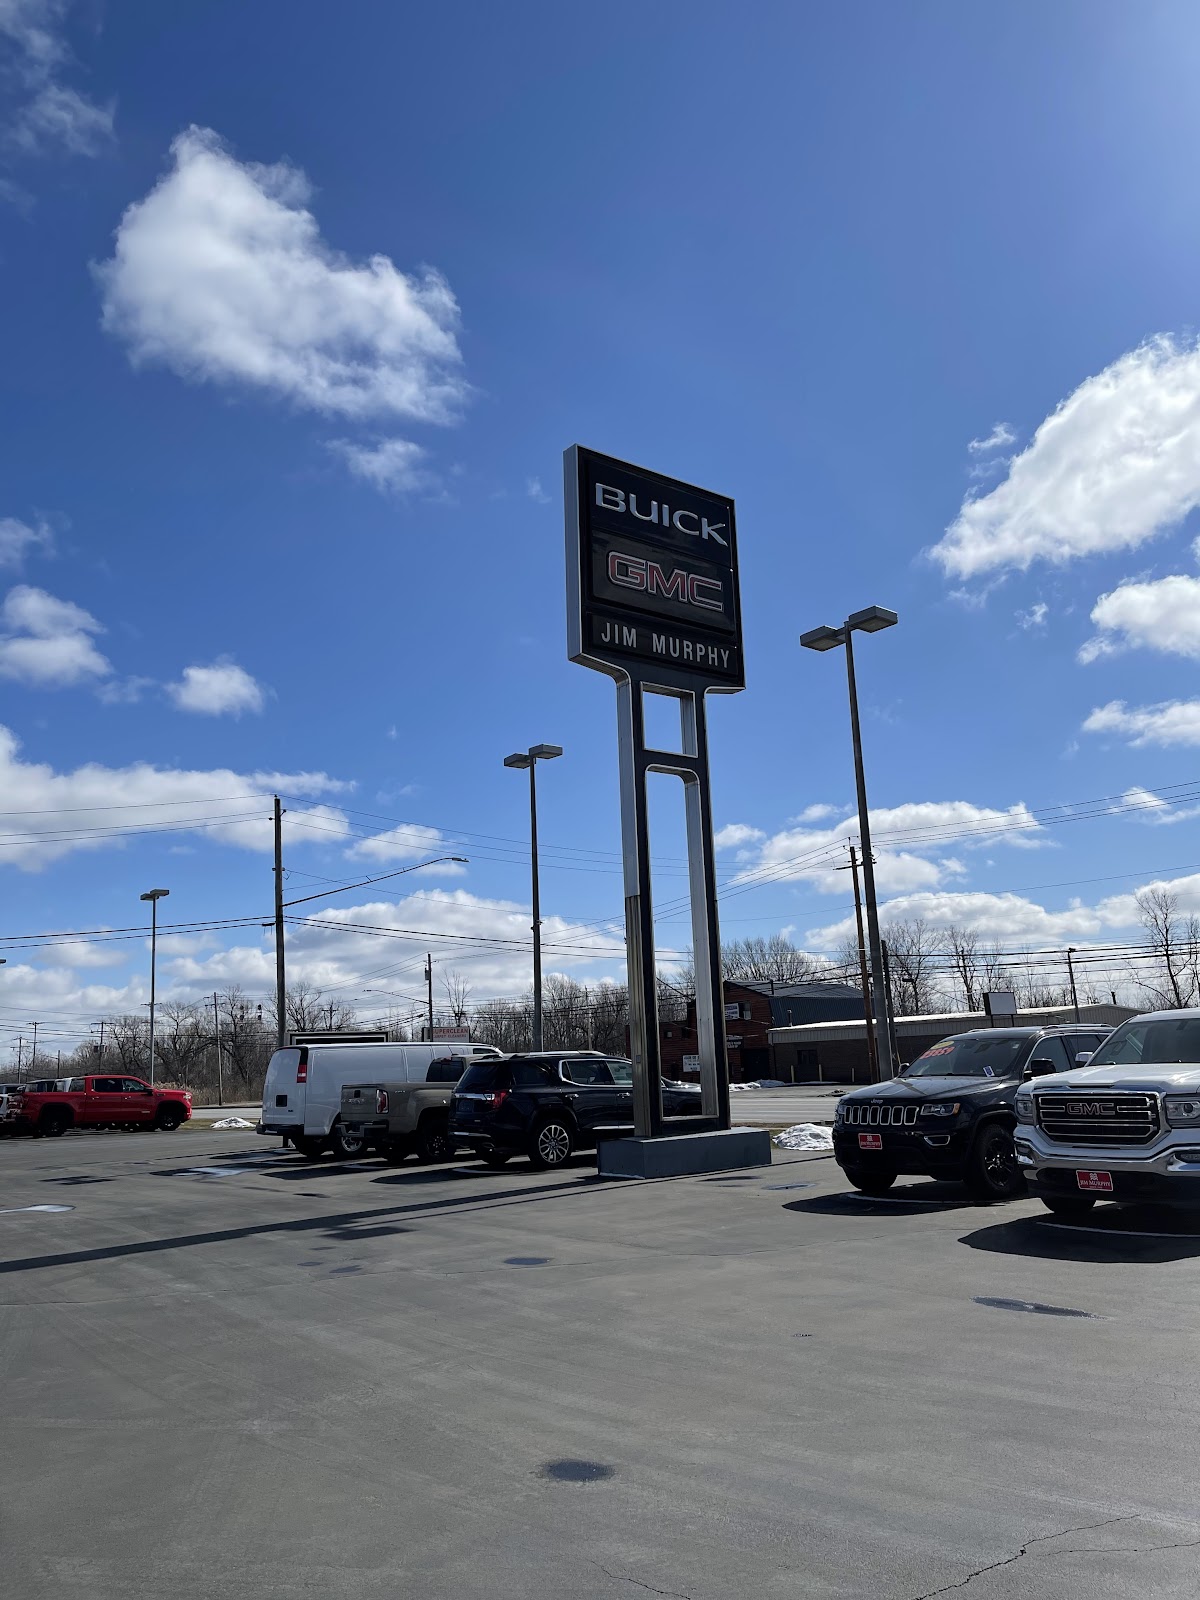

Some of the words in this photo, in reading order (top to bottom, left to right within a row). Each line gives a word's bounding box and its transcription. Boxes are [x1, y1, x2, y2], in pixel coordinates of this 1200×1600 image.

[595, 482, 729, 547] BUICK
[608, 551, 725, 613] GMC
[601, 622, 638, 649] JIM
[652, 633, 730, 669] MURPHY
[1066, 1102, 1116, 1115] GMC
